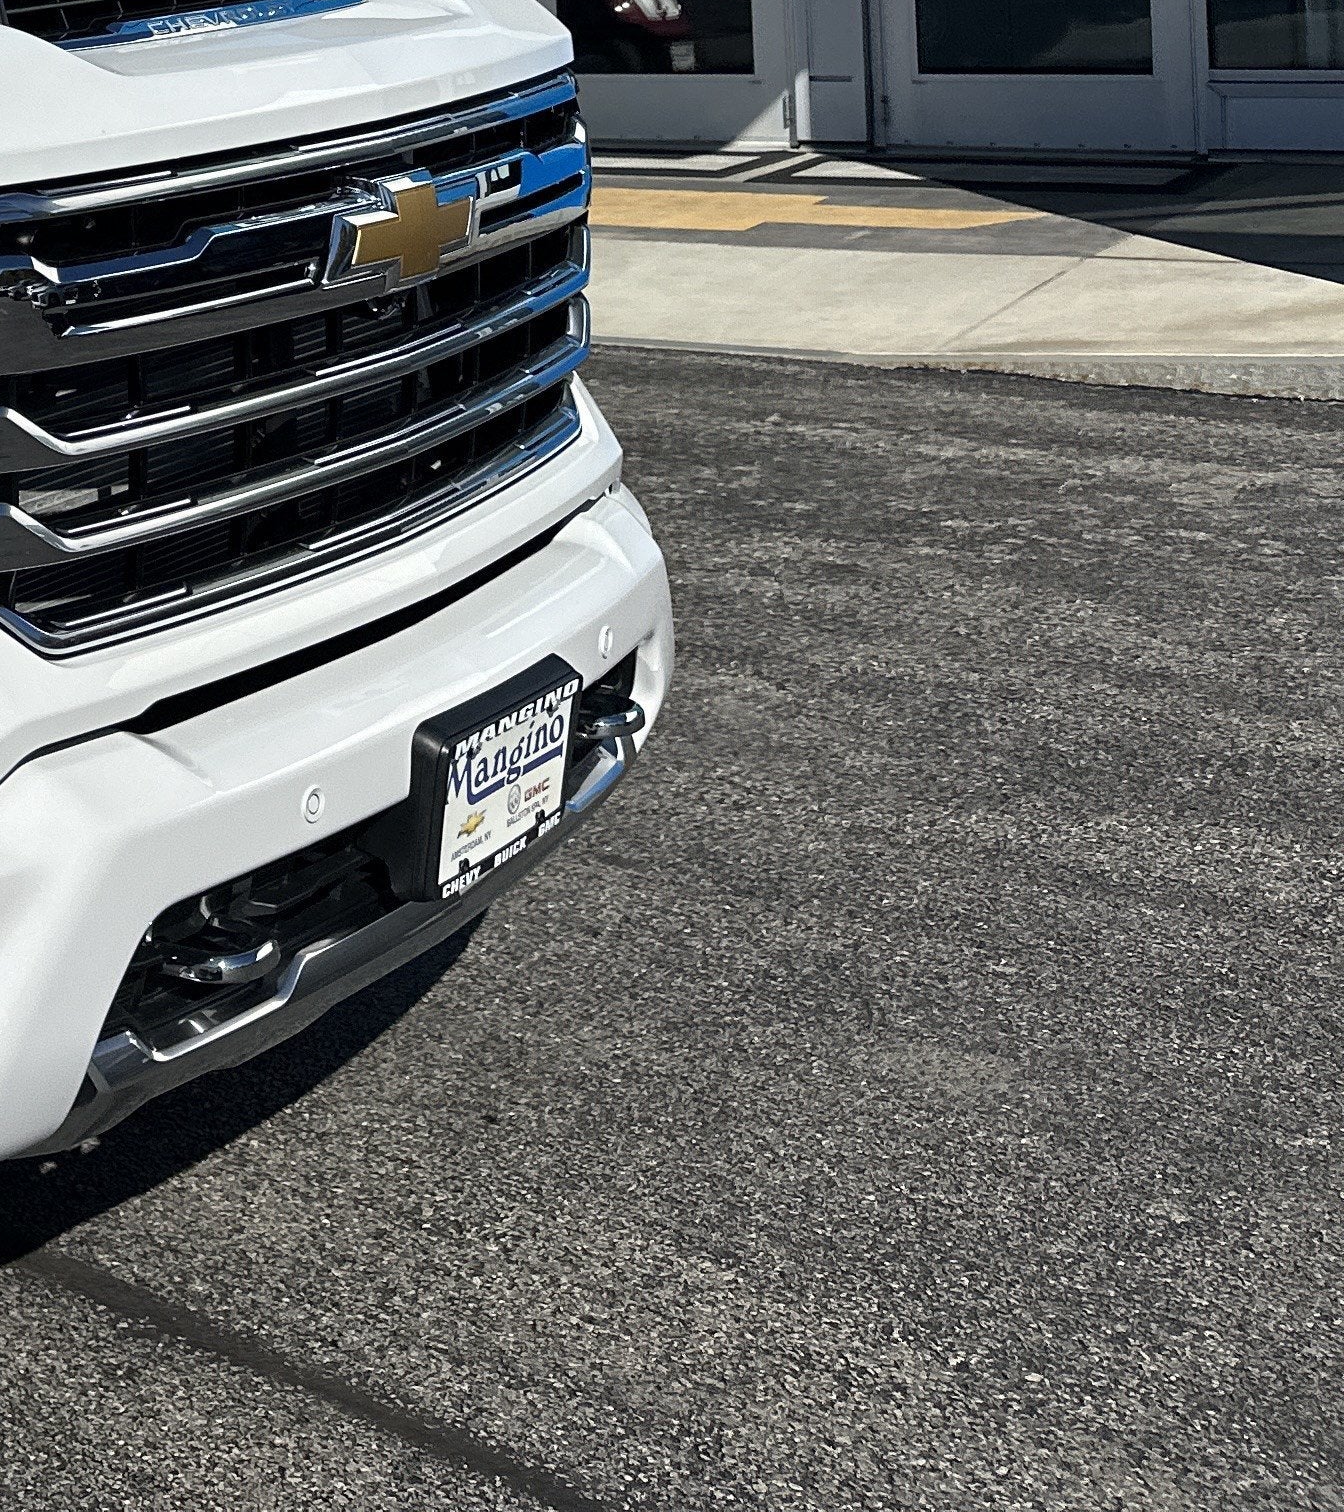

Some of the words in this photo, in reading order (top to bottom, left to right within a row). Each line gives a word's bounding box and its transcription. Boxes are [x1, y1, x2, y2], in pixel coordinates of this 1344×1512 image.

[147, 1, 296, 37] CHEVR
[446, 714, 565, 805] Mangino
[454, 678, 580, 761] MANGINO
[524, 776, 550, 803] GMC
[442, 866, 481, 899] CHEVY
[493, 836, 527, 868] BUICK
[538, 811, 561, 837] GMC
